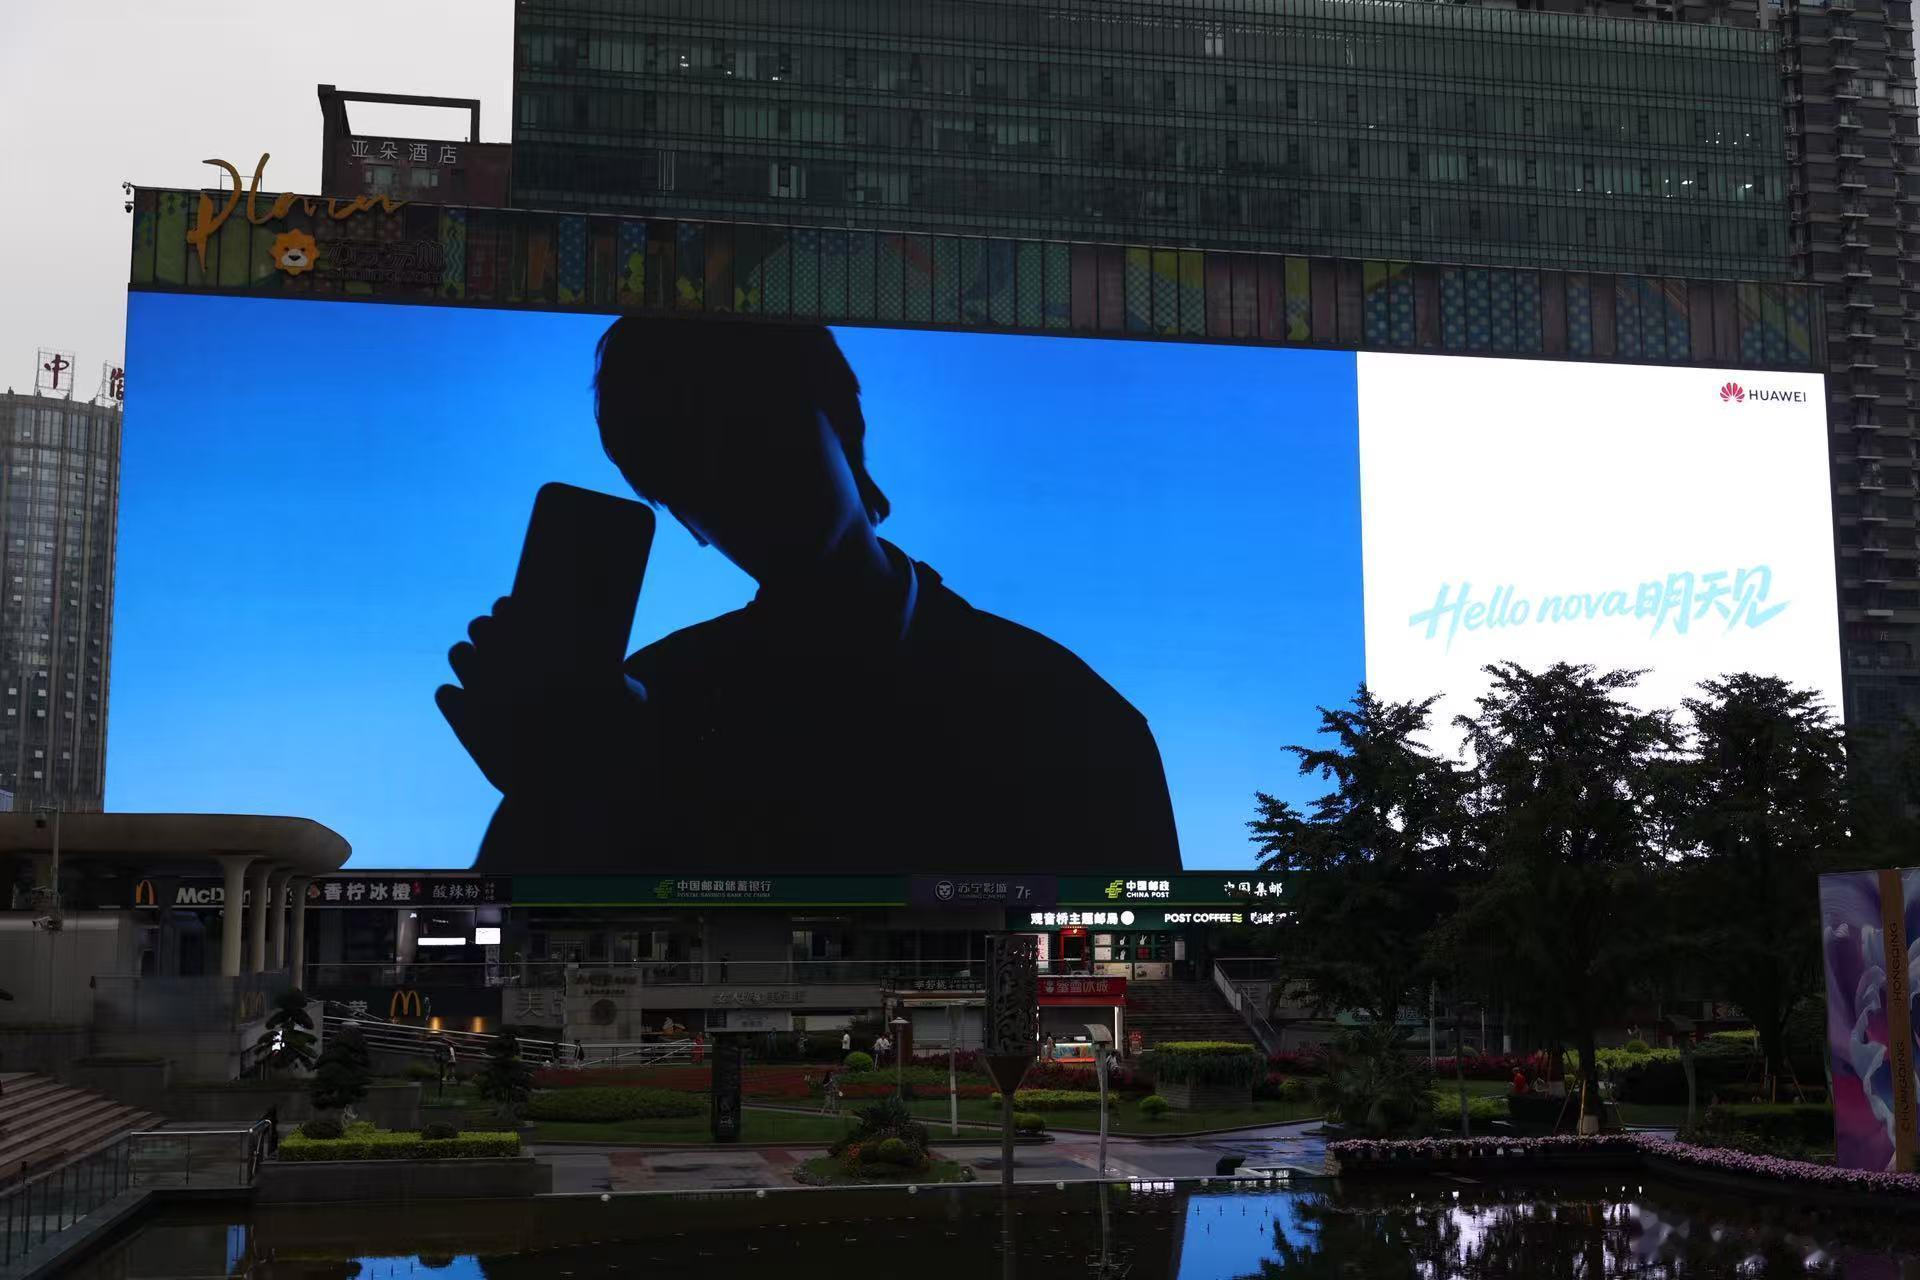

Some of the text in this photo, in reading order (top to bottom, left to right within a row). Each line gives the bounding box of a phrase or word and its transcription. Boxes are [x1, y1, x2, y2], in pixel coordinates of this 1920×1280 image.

[351, 139, 457, 164] 亚朵酒店
[1748, 389, 1807, 403] HUAWEI
[1408, 582, 1528, 656] Hello
[323, 882, 411, 901] 香柠冰橙
[431, 883, 481, 898] 酸辣粉
[677, 880, 772, 891] 中国邮政储蓄银行
[1015, 885, 1033, 899] 7F
[1125, 880, 1170, 891] 中国邮政
[1030, 912, 1119, 926] 观音桥主题邮局
[1164, 913, 1191, 923] POST
[1193, 913, 1232, 923] COFFEE
